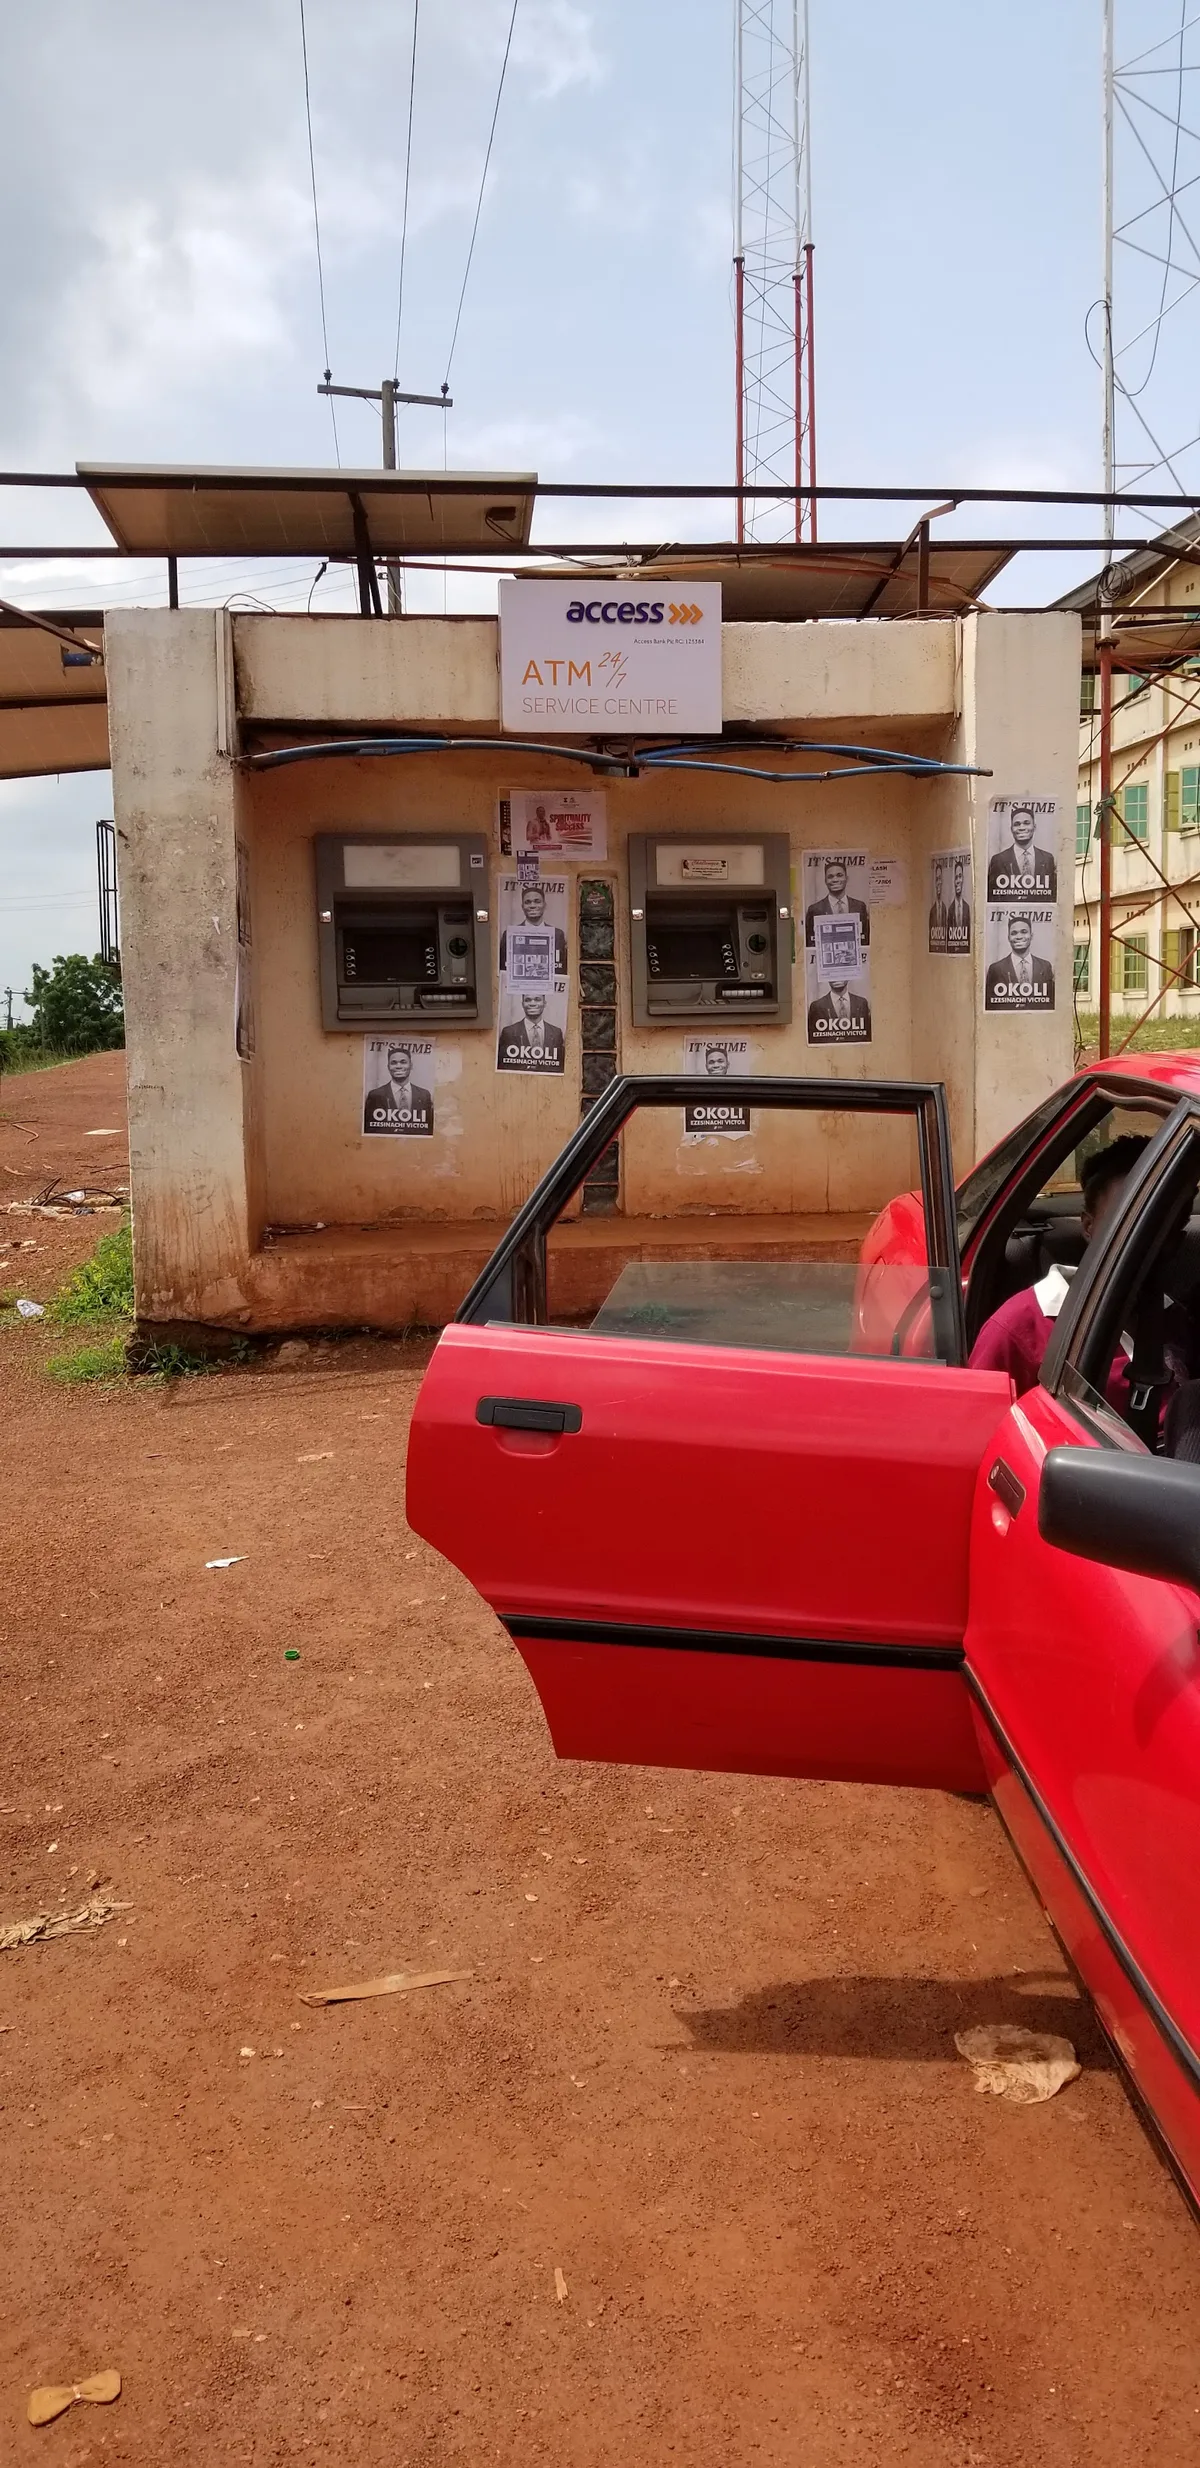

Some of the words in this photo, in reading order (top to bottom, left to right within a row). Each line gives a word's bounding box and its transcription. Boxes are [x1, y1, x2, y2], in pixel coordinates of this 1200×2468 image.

[566, 601, 665, 624] access
[521, 659, 592, 686] ATM
[598, 651, 629, 689] 24/7
[522, 697, 600, 714] SERVICE
[604, 698, 678, 715] CENTRE
[996, 874, 1050, 889] OKOLI
[948, 926, 968, 940] OKOLI
[993, 982, 1048, 997] OKOLI
[815, 1017, 865, 1032] OKOLI
[506, 1045, 558, 1060] OKOLI
[539, 1059, 560, 1067] VICTOR
[373, 1108, 426, 1122] OKOLI
[693, 1107, 743, 1120] OKOLI
